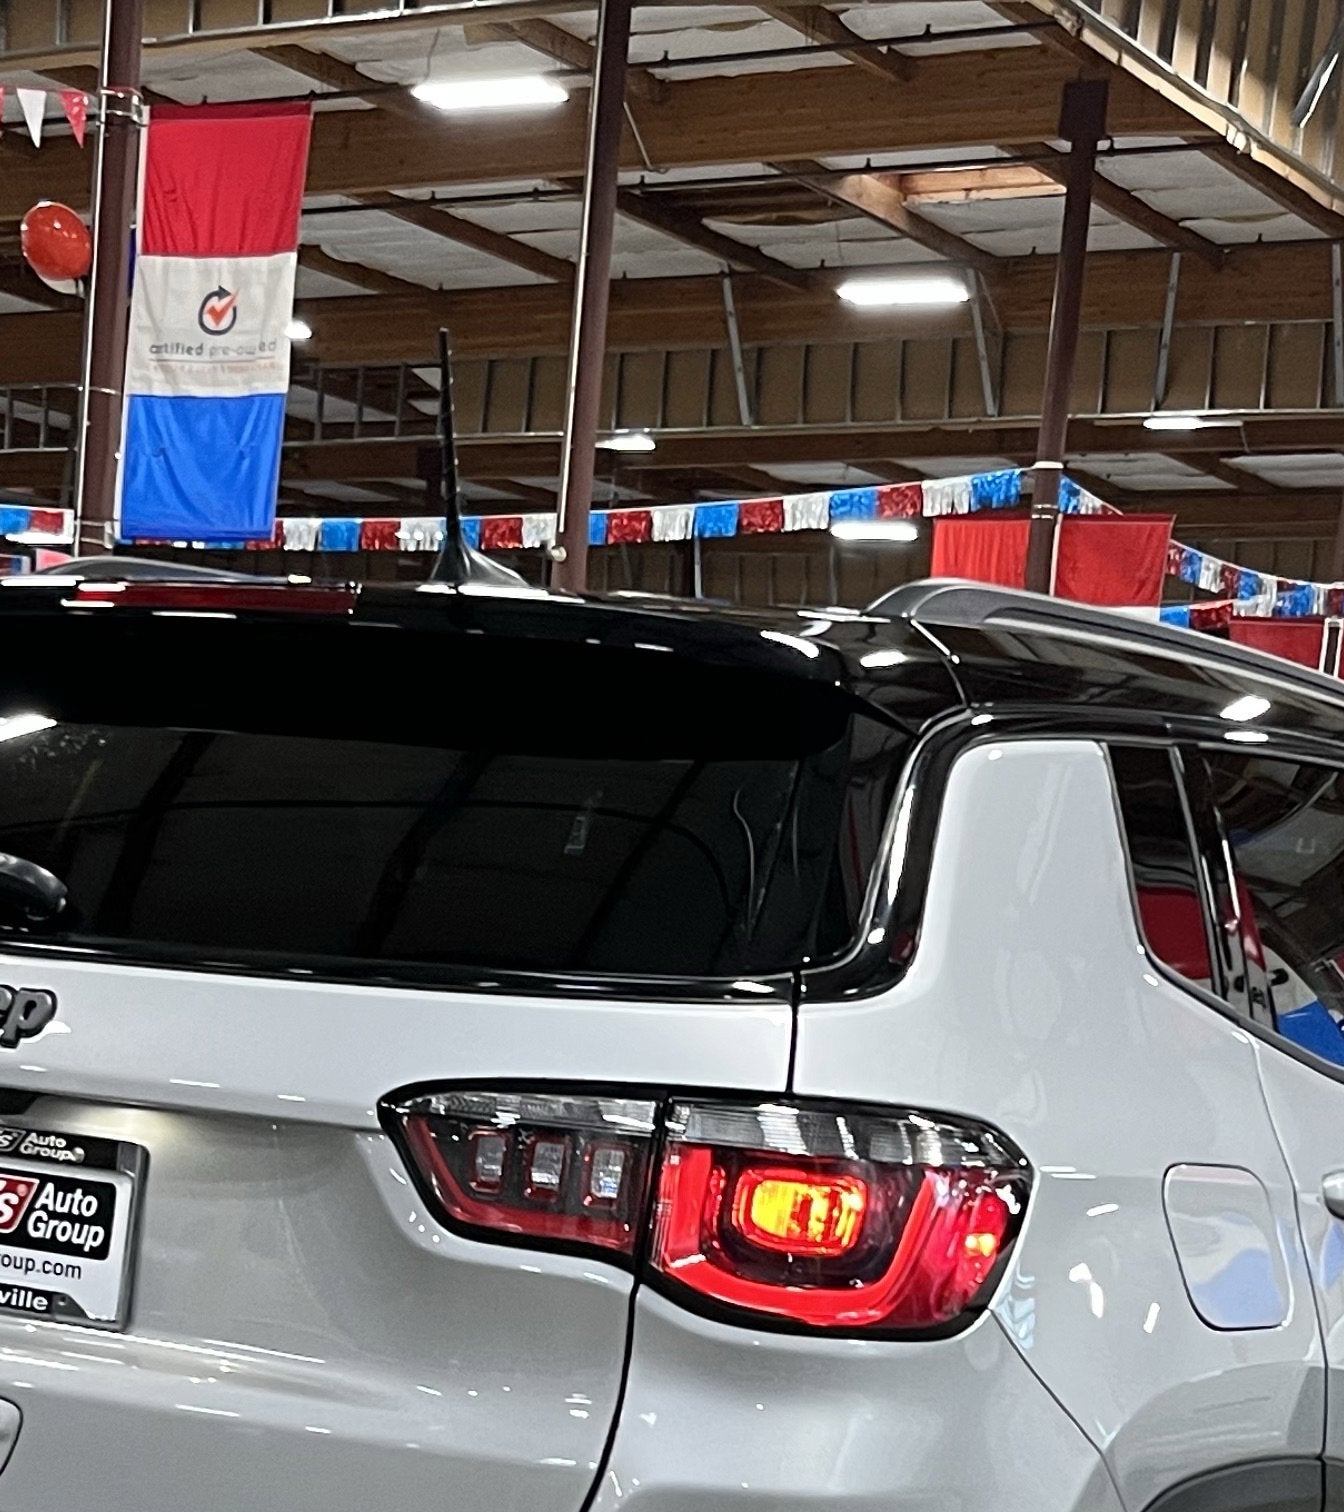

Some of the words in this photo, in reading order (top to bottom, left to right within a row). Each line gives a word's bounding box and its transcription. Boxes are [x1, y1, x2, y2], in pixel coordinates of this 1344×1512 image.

[149, 342, 204, 356] ctified
[25, 1132, 67, 1148] Auto
[19, 1142, 75, 1162] Group
[35, 1183, 98, 1217] Auto
[27, 1213, 105, 1252] Group
